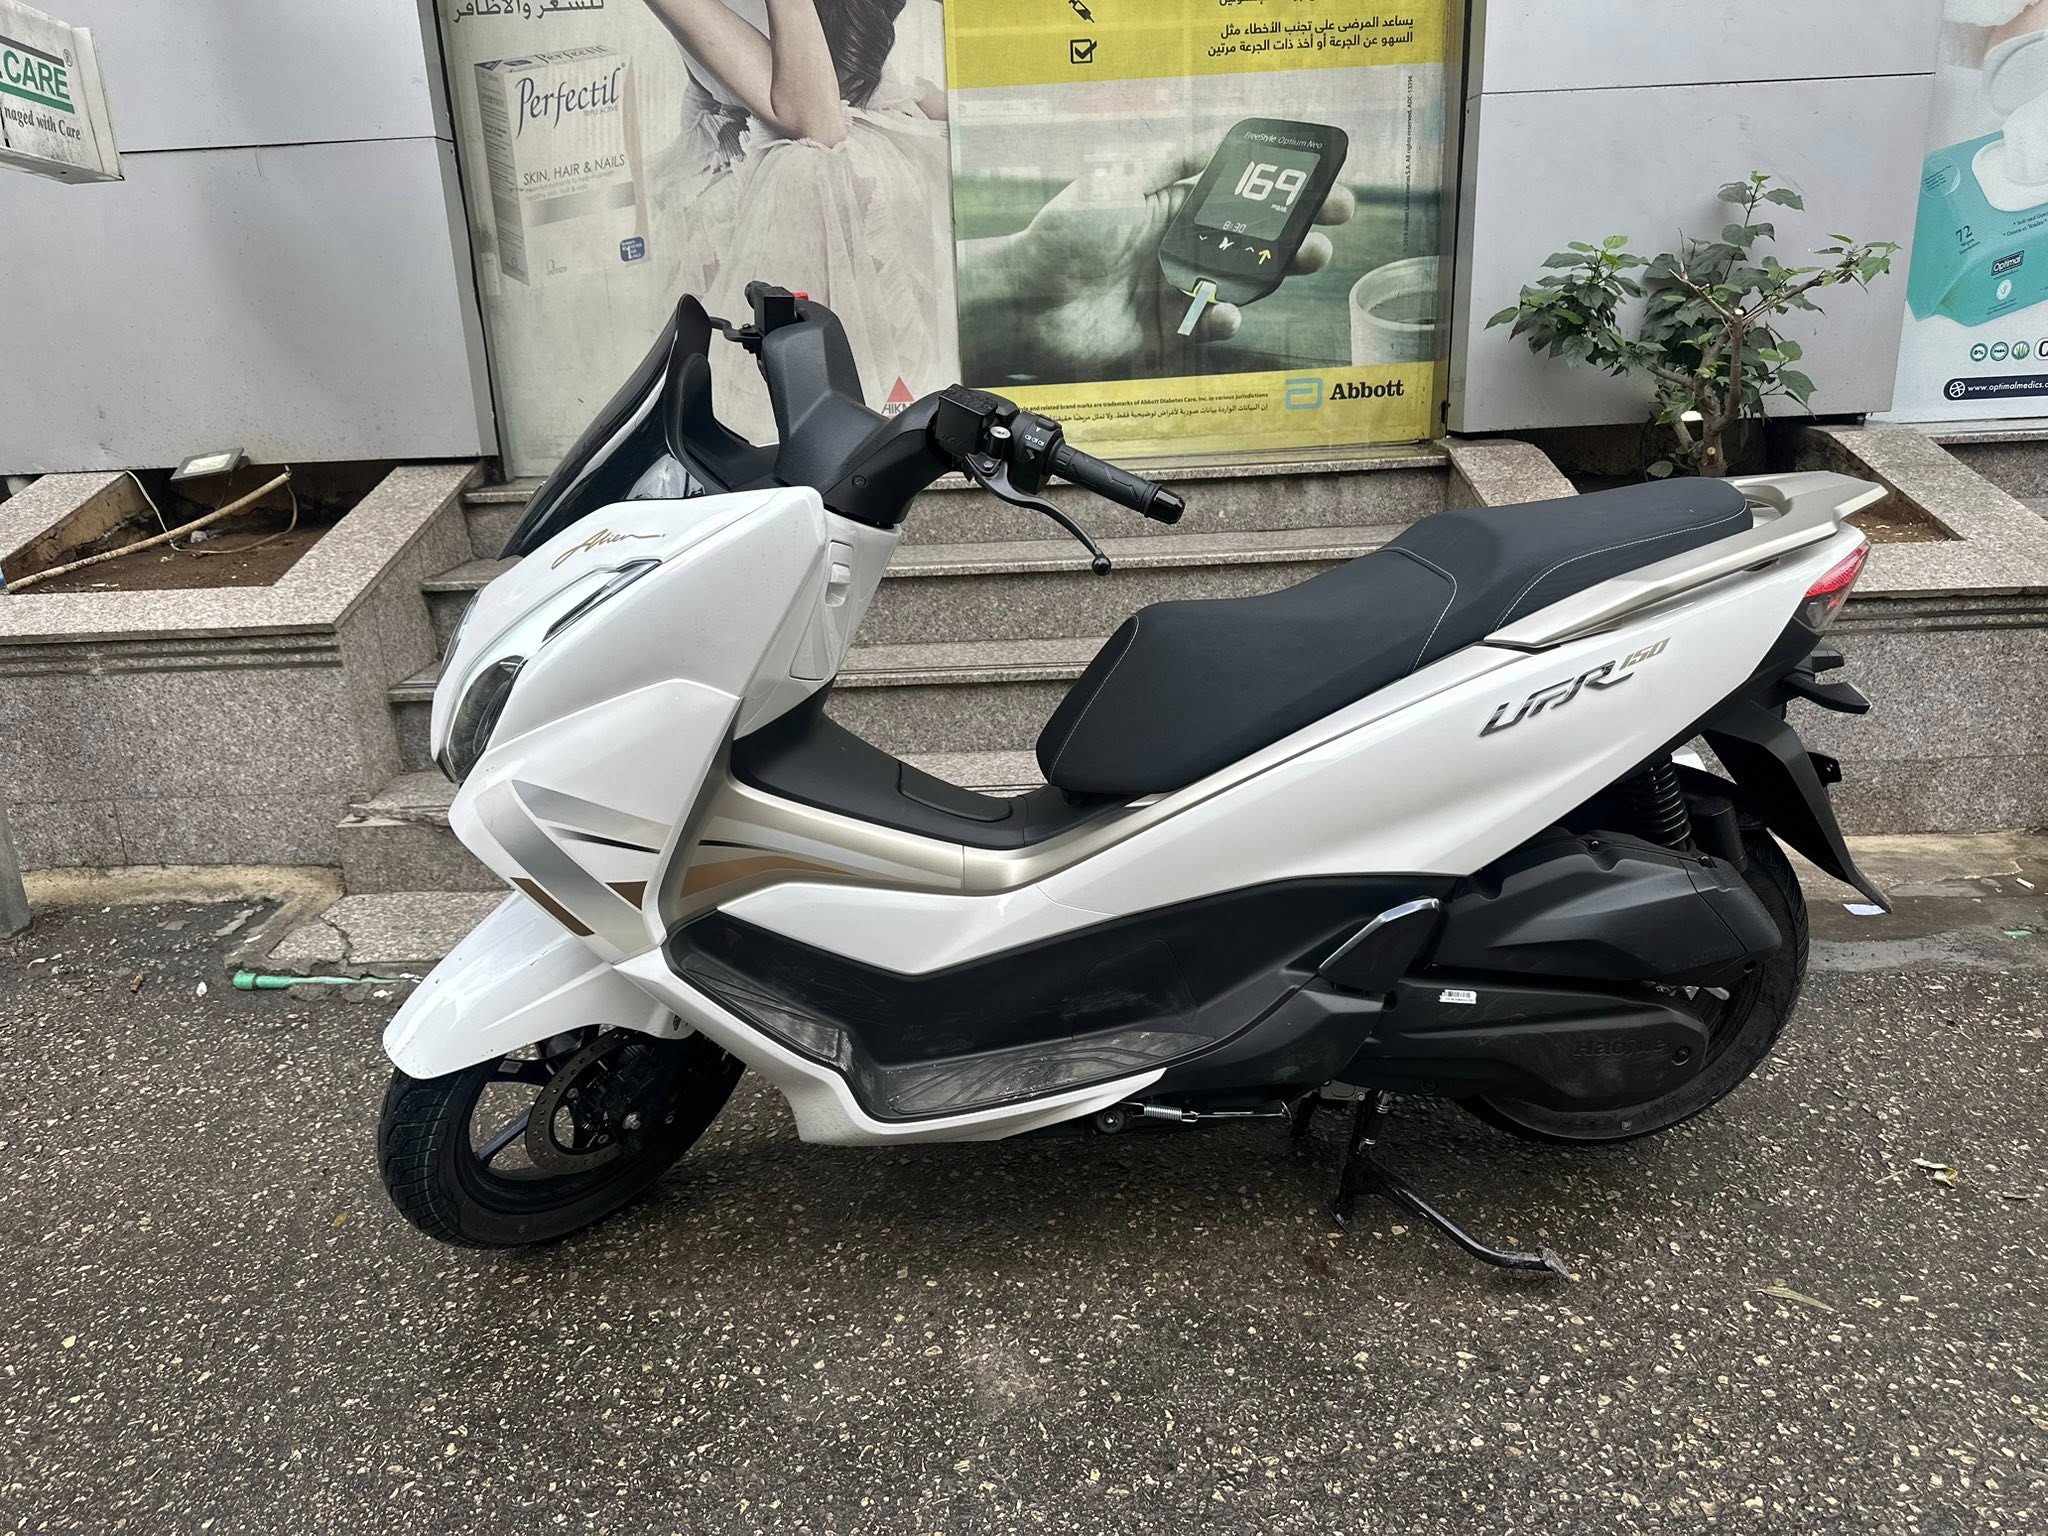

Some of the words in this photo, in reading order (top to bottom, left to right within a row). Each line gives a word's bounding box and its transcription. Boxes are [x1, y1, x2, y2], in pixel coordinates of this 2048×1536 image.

[1245, 21, 1281, 35] الأخطاء
[1284, 21, 1312, 35] تجنب
[1314, 19, 1335, 33] على
[1338, 16, 1379, 32] المرضى
[1382, 15, 1414, 29] يساعد
[1221, 25, 1241, 39] مثل
[1381, 32, 1413, 46] السهو
[1239, 40, 1270, 54] الجرعة
[1273, 38, 1294, 50] ذات
[1298, 34, 1314, 49] أخذ
[1317, 35, 1327, 50] أو
[1330, 35, 1360, 49] الجرعة
[1363, 37, 1378, 48] عن
[1207, 42, 1236, 57] مرتين
[3, 50, 71, 101] CARE
[514, 66, 622, 139] Perfectil
[3, 106, 34, 128] naged
[36, 114, 57, 132] with
[58, 119, 81, 140] Care
[523, 169, 551, 186] SKIN,
[554, 163, 580, 179] HAIR
[583, 161, 591, 174] &
[594, 154, 625, 170] NAILS
[1234, 161, 1307, 206] 169
[1223, 220, 1246, 233] 8:30
[1955, 225, 1973, 242] 72
[1993, 255, 2021, 272] Optimal
[1235, 392, 1269, 400] jurisdictions
[1329, 379, 1405, 400] Abbott
[1618, 637, 1671, 671] 150
